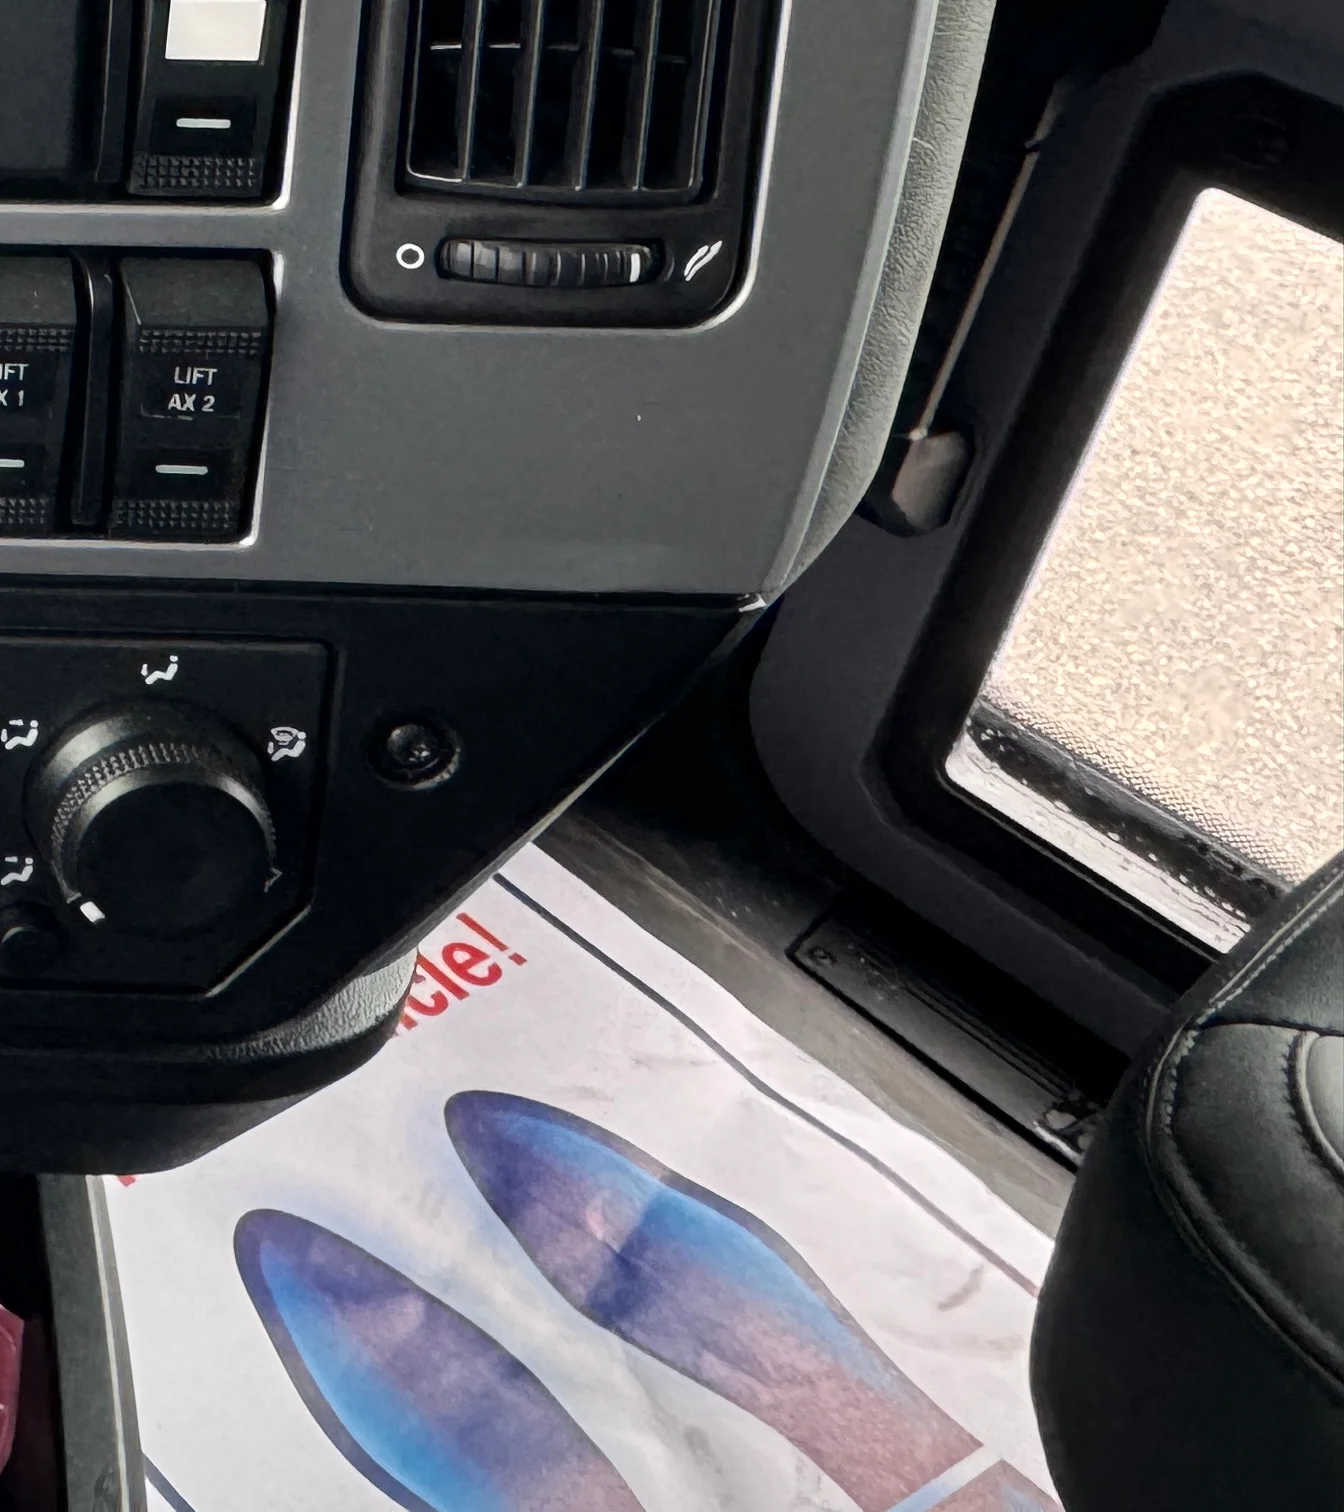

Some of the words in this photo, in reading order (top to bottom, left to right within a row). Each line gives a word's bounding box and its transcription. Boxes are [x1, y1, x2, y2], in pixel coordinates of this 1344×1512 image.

[174, 366, 218, 386] LIFT
[16, 389, 25, 407] 1
[168, 394, 196, 413] AX
[202, 394, 215, 412] 2
[400, 912, 528, 1031] cle!
